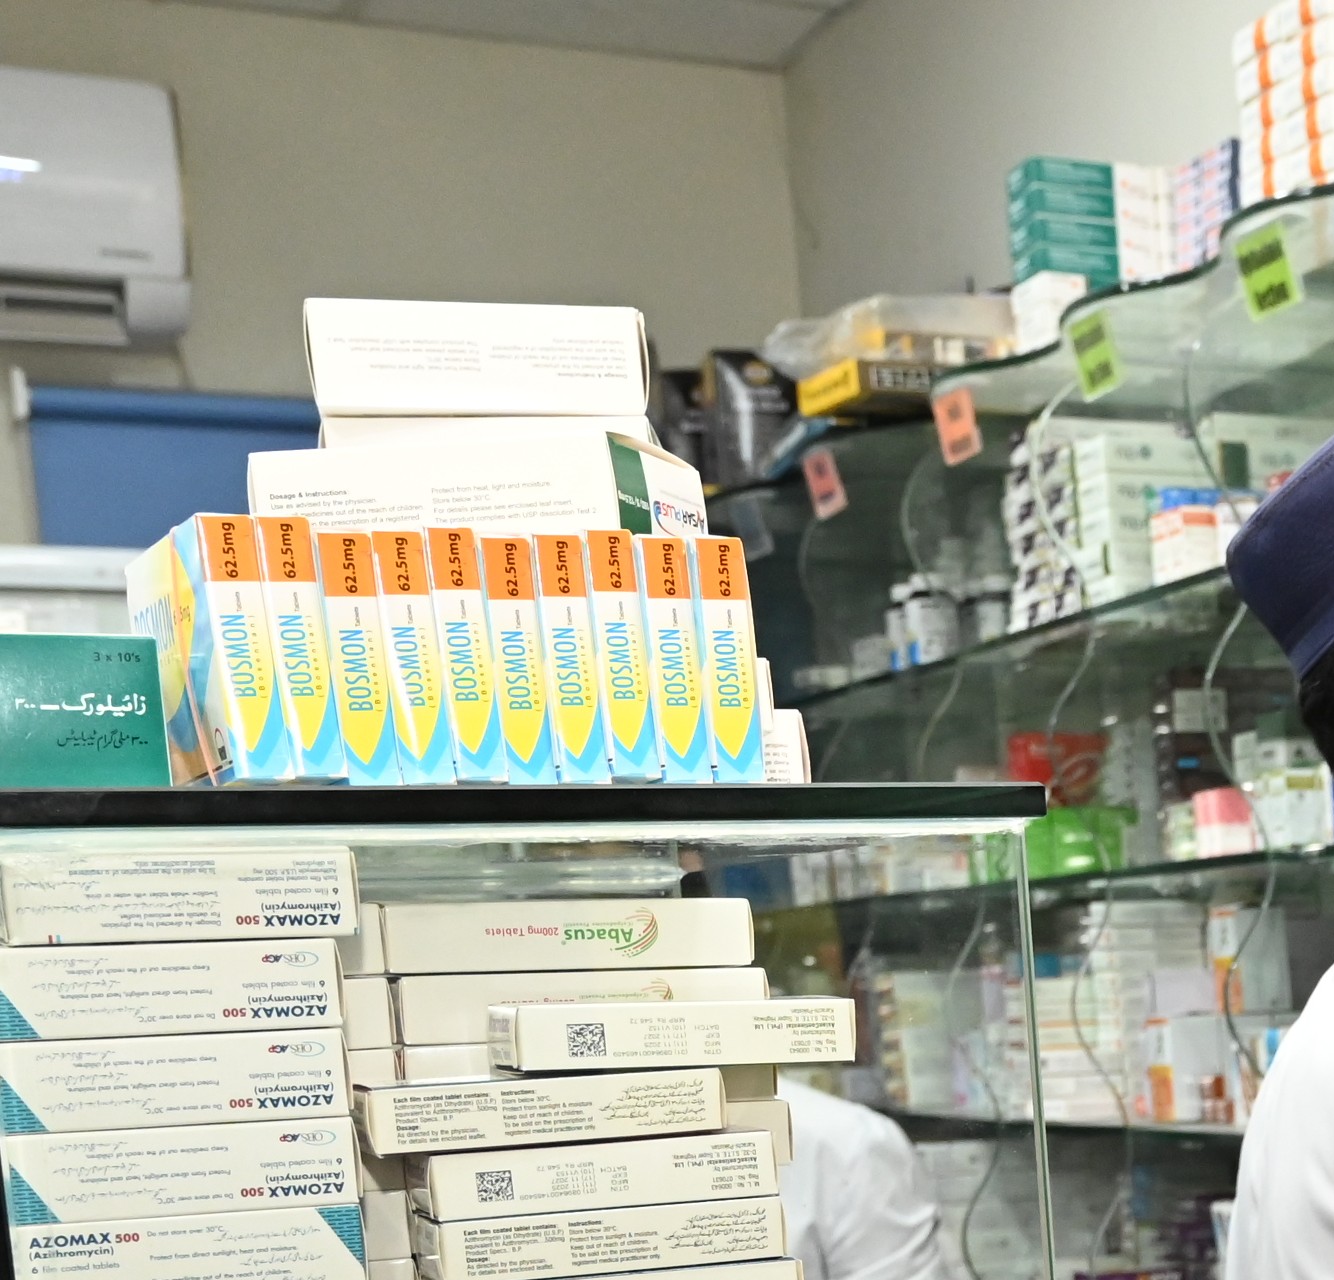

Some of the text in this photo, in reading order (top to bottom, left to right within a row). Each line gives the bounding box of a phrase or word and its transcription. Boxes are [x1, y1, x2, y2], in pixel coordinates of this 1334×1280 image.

[222, 522, 238, 579] 62.5mg
[343, 538, 358, 594] 62.5mg
[449, 533, 463, 587] 62.5mg
[608, 536, 622, 589] 62.5mg
[718, 544, 730, 597] 62.5mg
[93, 652, 100, 661] 3
[117, 652, 141, 663] 10's
[220, 614, 257, 698] BOSMON
[339, 629, 374, 712] BOSMON
[501, 631, 532, 710] BOSMON
[605, 622, 635, 700] BOSMON
[713, 630, 741, 707] BOSMON
[236, 913, 340, 927] AZOMAX 500
[261, 902, 341, 914] (Azithromycin)
[485, 927, 526, 937] Tablets
[564, 927, 634, 942] Abacus
[229, 1094, 333, 1109] AZOMAX 500
[31, 1267, 38, 1275] 6
[59, 1262, 91, 1273] coated
[93, 1261, 120, 1270] tablets
